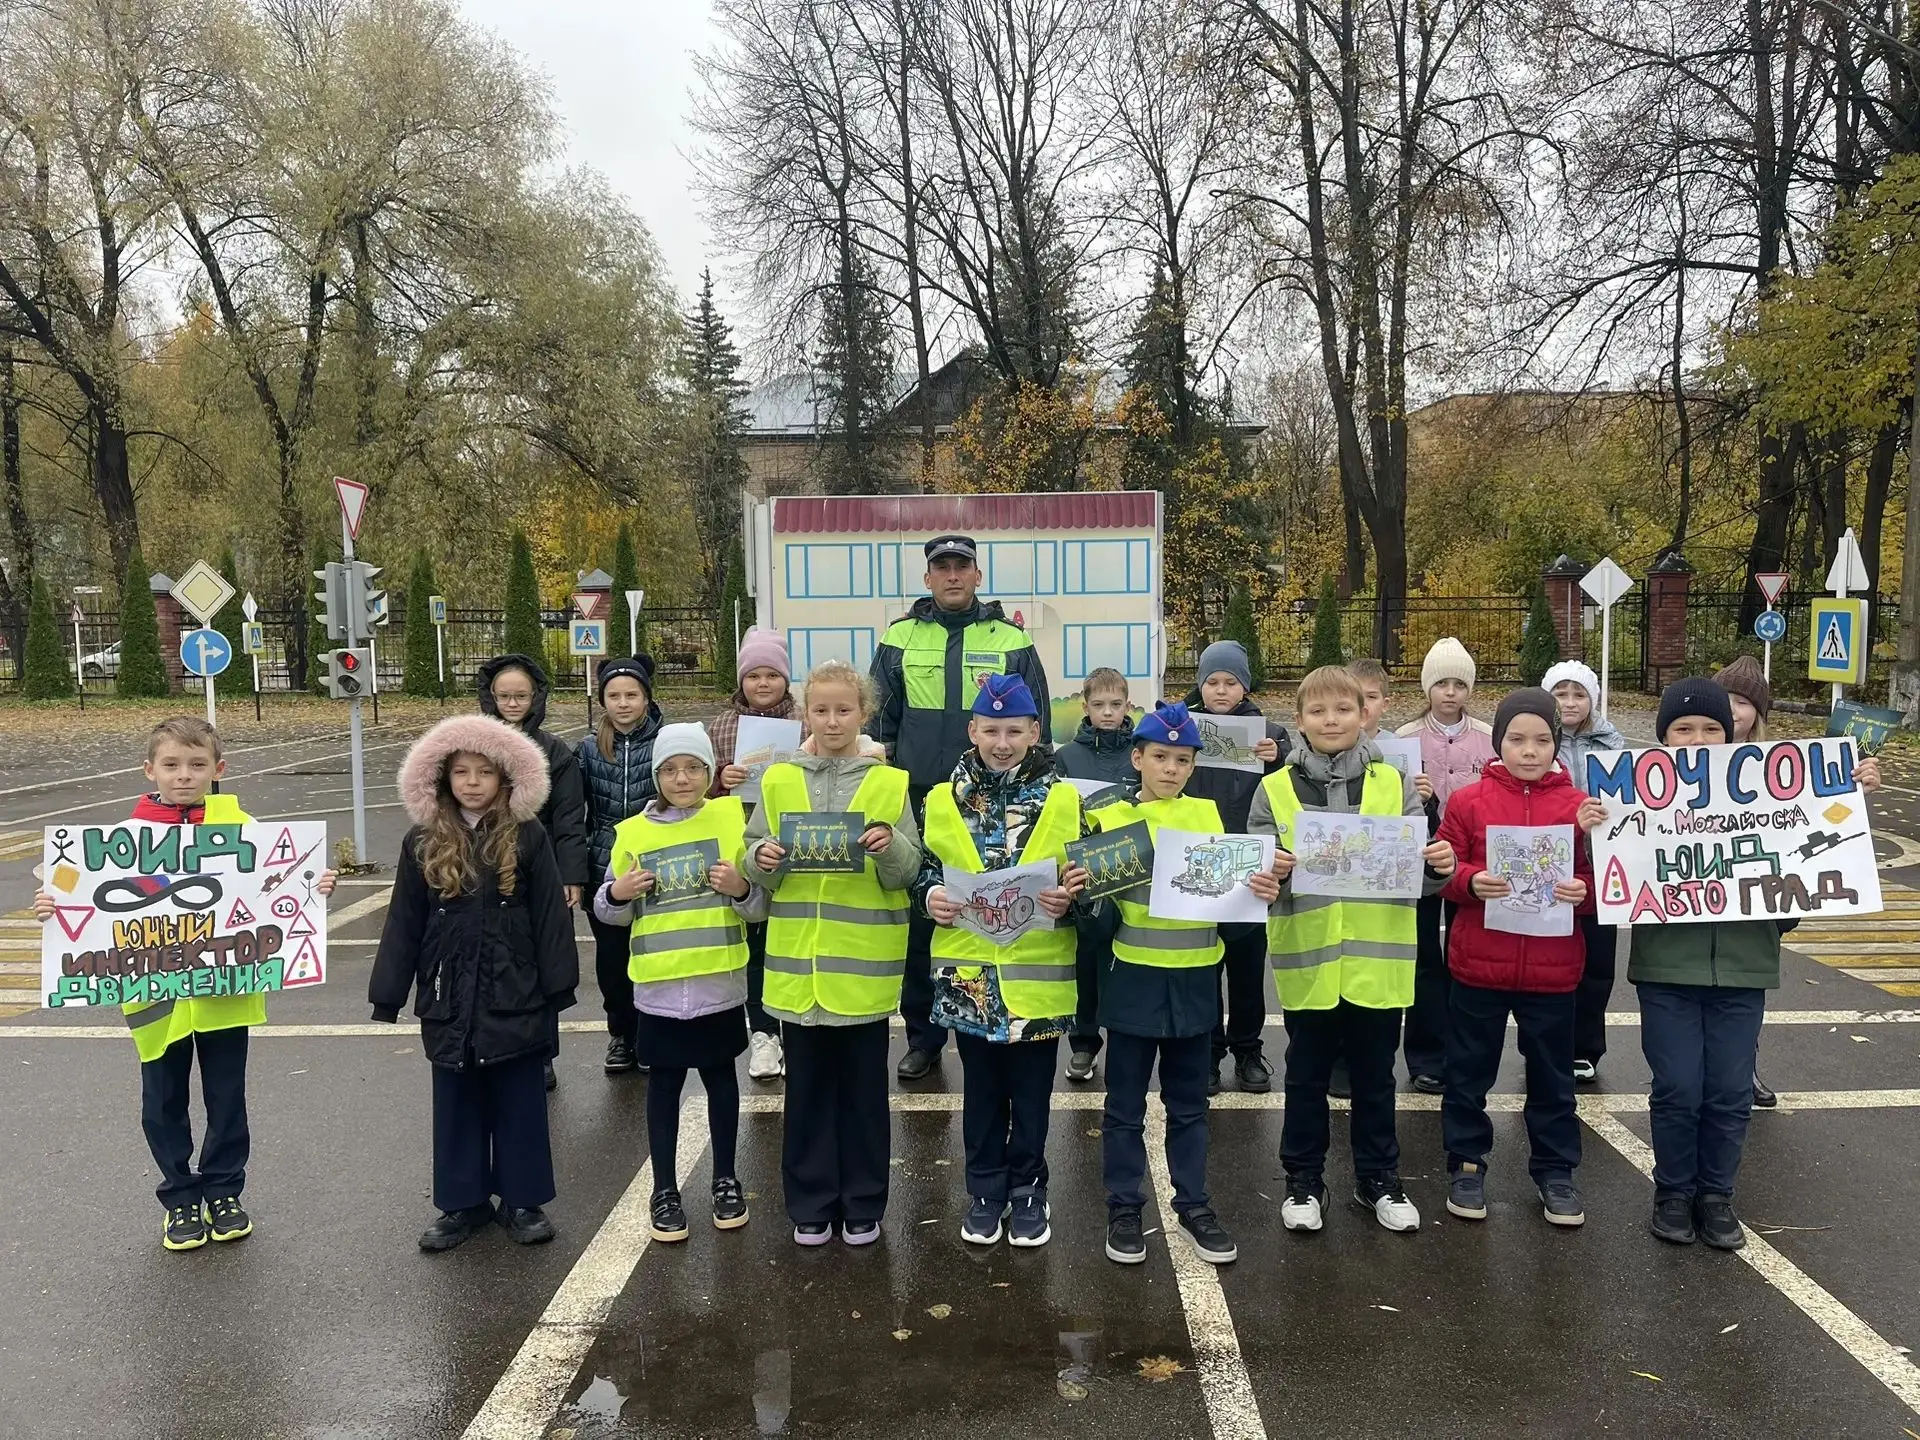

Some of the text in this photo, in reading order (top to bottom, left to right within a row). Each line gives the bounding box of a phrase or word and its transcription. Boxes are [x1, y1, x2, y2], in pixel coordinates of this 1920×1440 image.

[1586, 742, 1857, 810] МОУ СОШ
[83, 823, 257, 873] ЮИД
[1655, 834, 1781, 882] ЮИД
[277, 902, 294, 913] 20
[1739, 870, 1858, 915] ГРАД
[62, 925, 283, 976] ИНСПЕКТОР
[112, 910, 216, 950] ЮНЫЙ
[49, 957, 285, 1008] ДВИЖЕНИЯ
